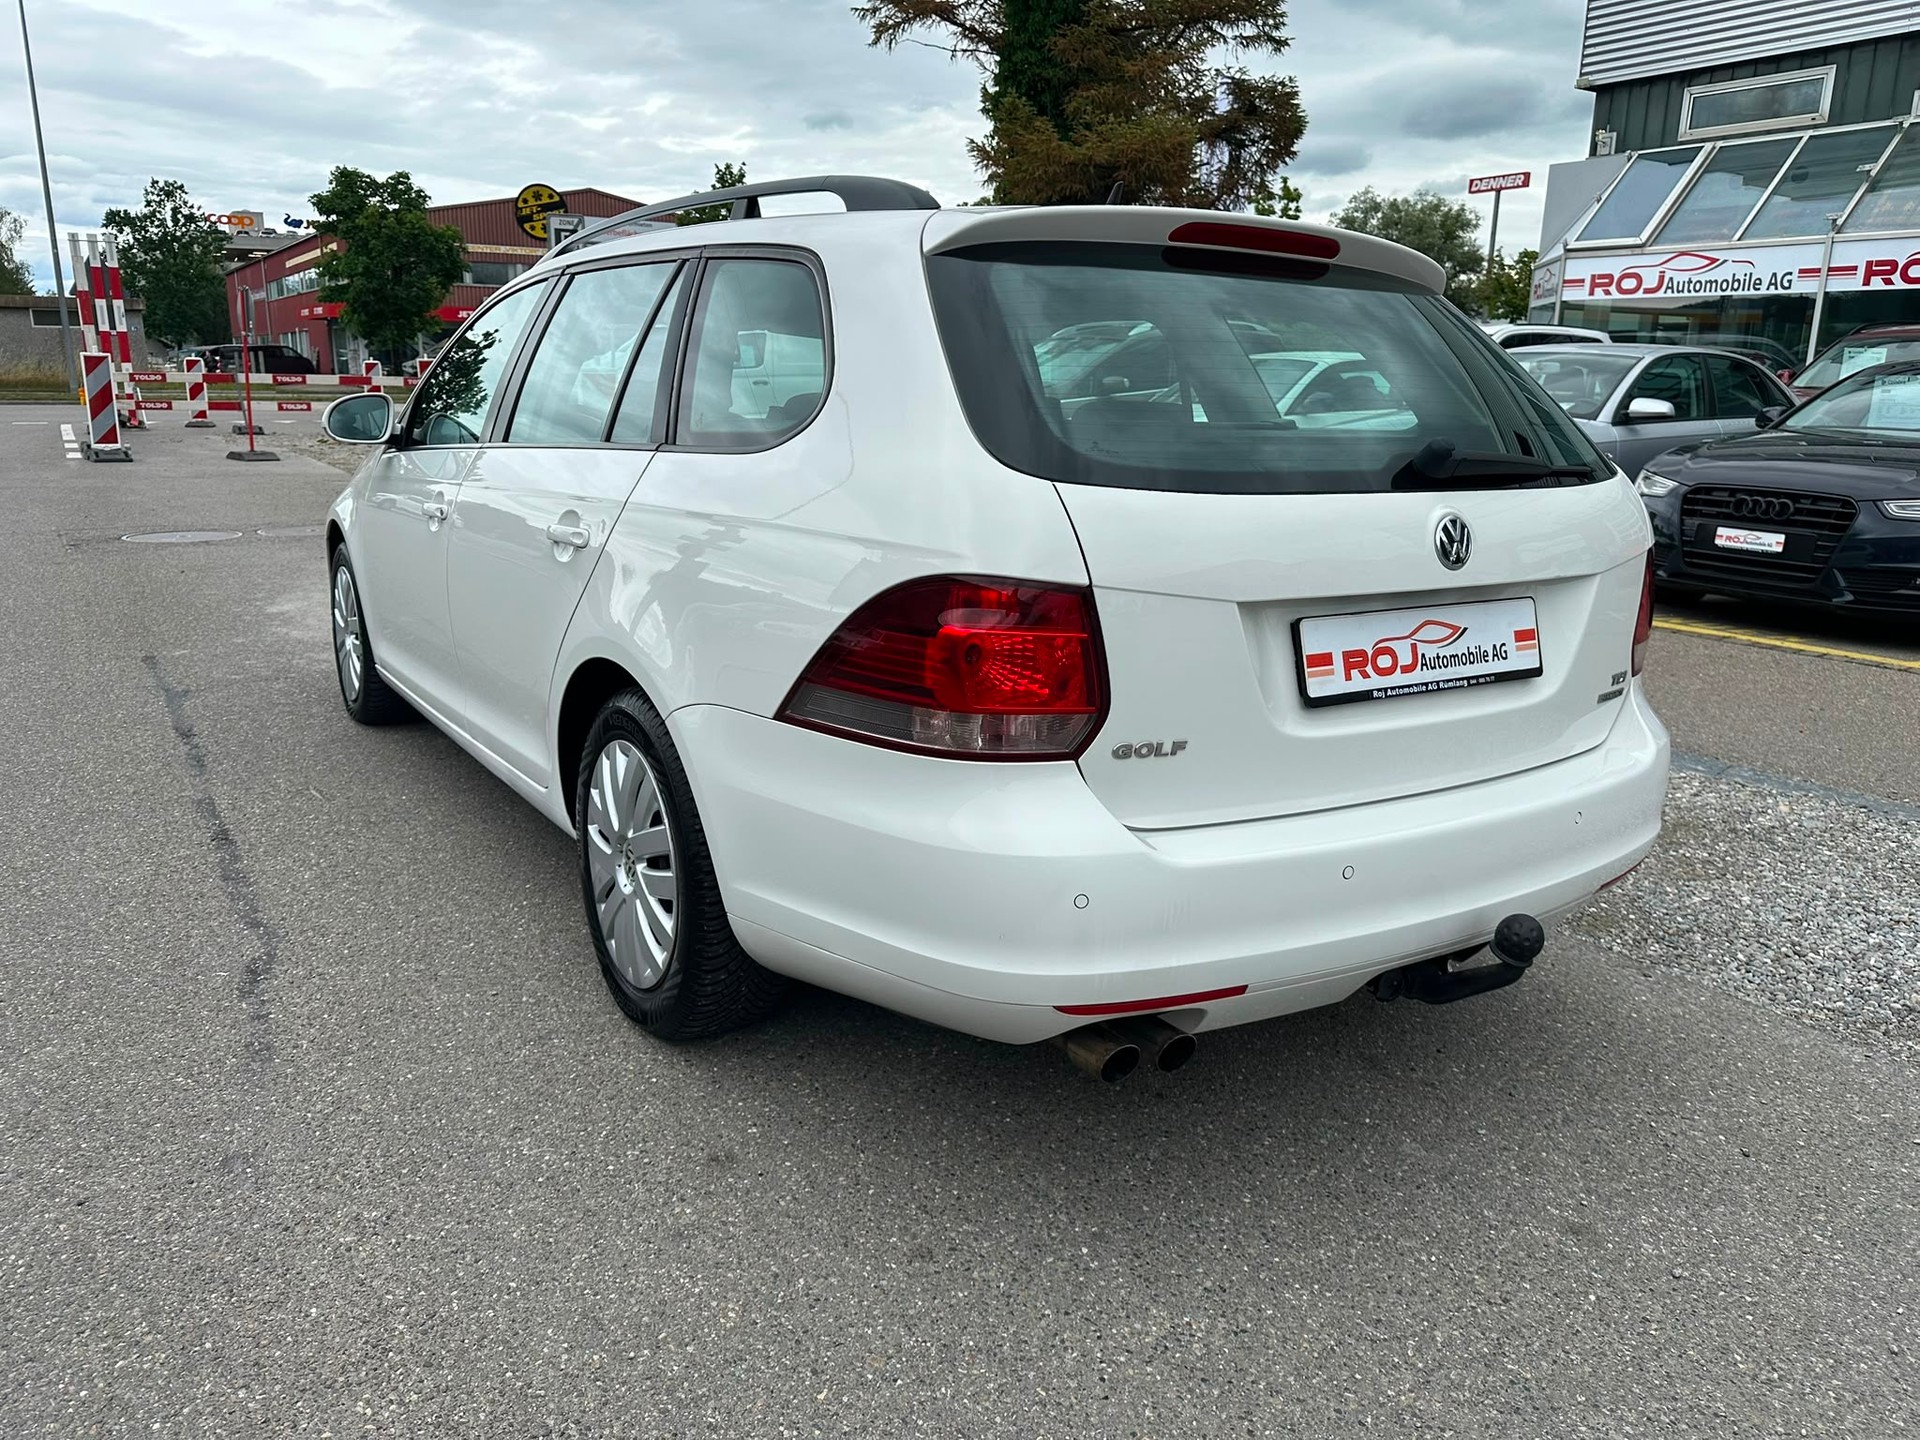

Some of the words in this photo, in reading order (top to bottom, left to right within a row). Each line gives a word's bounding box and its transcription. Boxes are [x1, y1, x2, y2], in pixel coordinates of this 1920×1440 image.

[1470, 174, 1525, 192] DENNER
[206, 213, 255, 229] coop
[1587, 270, 1666, 297] ROJ
[1664, 272, 1763, 295] Automobile
[1766, 270, 1793, 291] AG
[1342, 642, 1419, 682] ROJ
[1420, 645, 1490, 672] Automobile
[1491, 642, 1508, 662] AG
[1373, 690, 1386, 699] Roj
[1387, 683, 1427, 696] Automobile
[1428, 683, 1438, 691] AG
[1439, 679, 1468, 690] Rümlang
[1111, 739, 1188, 760] GOLF
